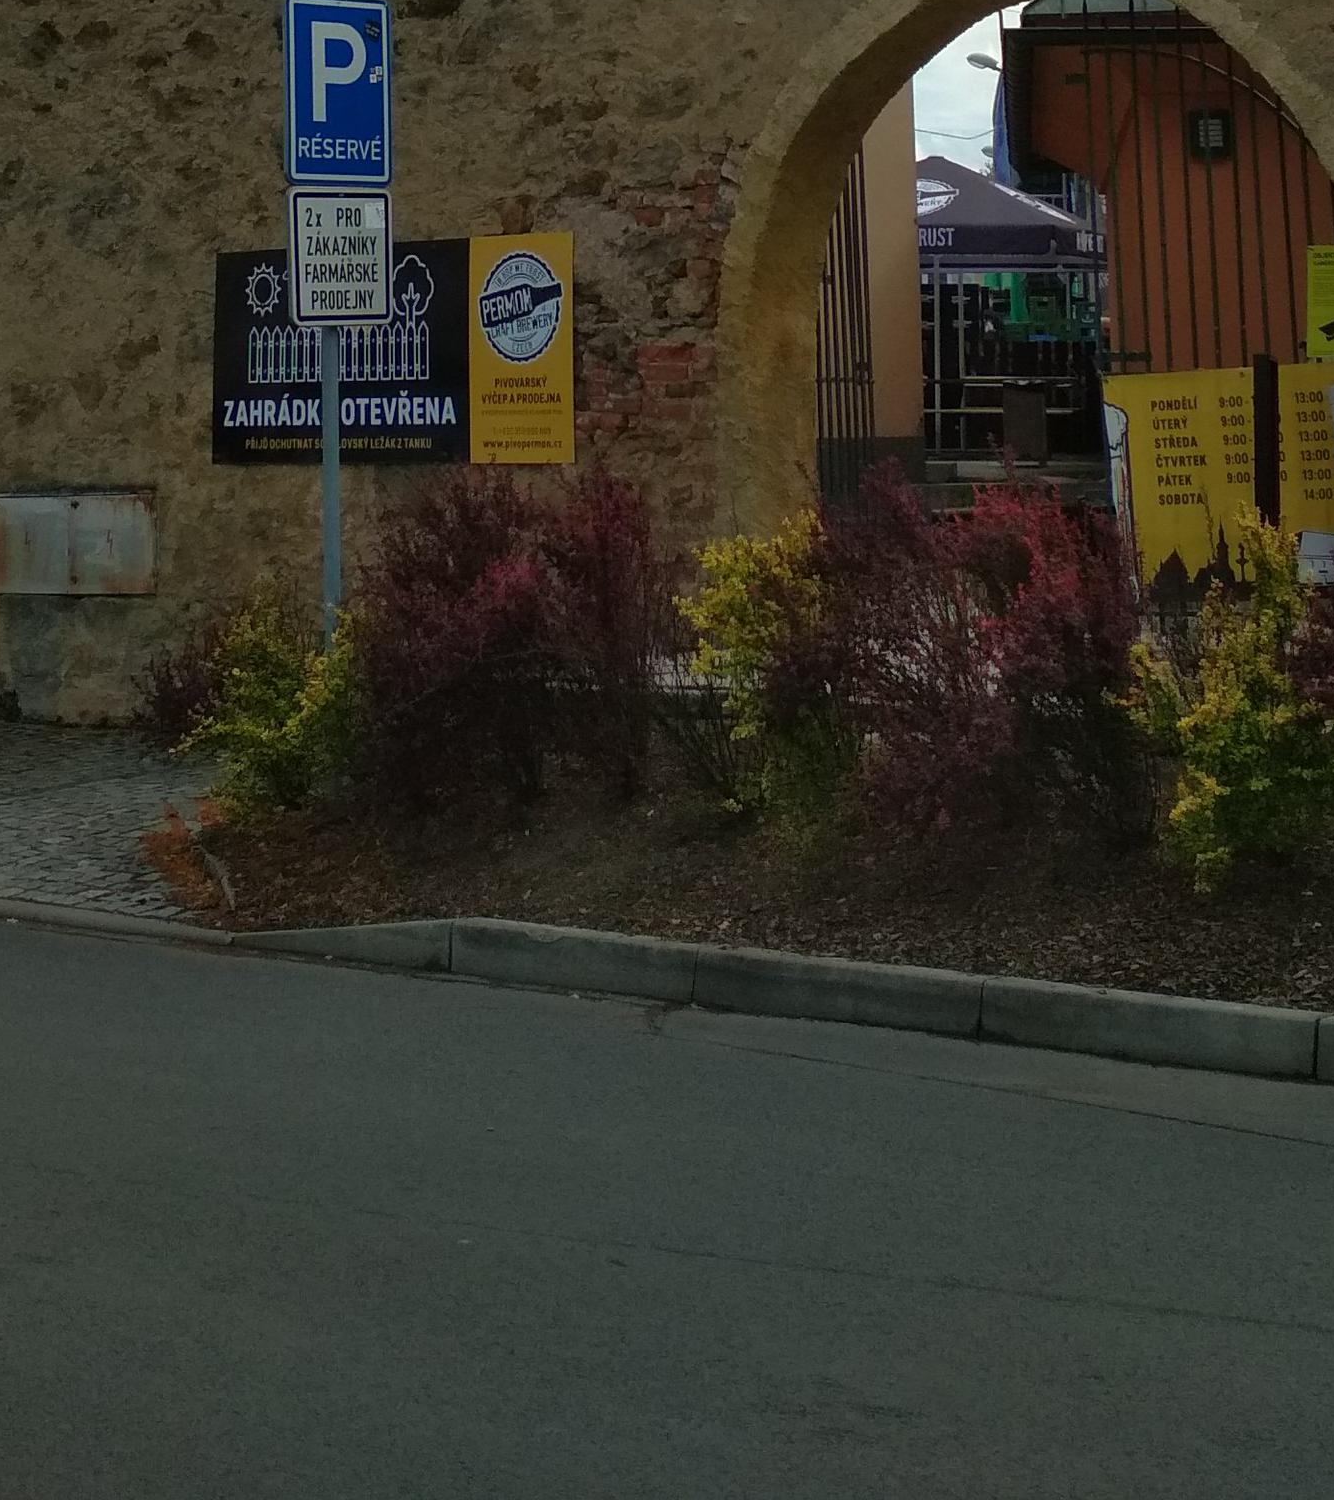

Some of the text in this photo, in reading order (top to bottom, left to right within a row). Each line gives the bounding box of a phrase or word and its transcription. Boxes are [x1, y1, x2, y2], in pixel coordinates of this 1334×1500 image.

[311, 21, 367, 122] P
[298, 133, 382, 161] RÉSERVÉ
[336, 208, 361, 228] PRO
[306, 231, 377, 257] ZÁKAZNÍKY
[919, 228, 955, 246] RUST
[304, 257, 379, 284] FARMÁŘSKÉ
[311, 290, 375, 310] PRODEJNY
[482, 286, 533, 323] PERMON
[224, 390, 457, 427] ZAHRÁDK OTEVŘENA
[509, 394, 515, 404] A
[516, 393, 562, 404] PRODEJNA
[1151, 391, 1323, 411] PONDĚLÍ 9:00 13:00
[1152, 410, 1326, 430] ÚTERÝ 9:00 13:00
[269, 438, 313, 449] OCHUTNAT
[370, 436, 396, 449] LEŽÁK
[403, 437, 432, 449] TANKU
[1154, 429, 1328, 449] STŘEDA 9:00 13:00
[1155, 449, 1330, 468] ČTVRTEK 9:00 13:00
[1157, 473, 1192, 487] PÁTEK
[1227, 471, 1250, 483] 9:00
[1302, 468, 1331, 480] 13:00
[1158, 493, 1204, 505] SOBOTA
[1303, 488, 1333, 500] 14:00
